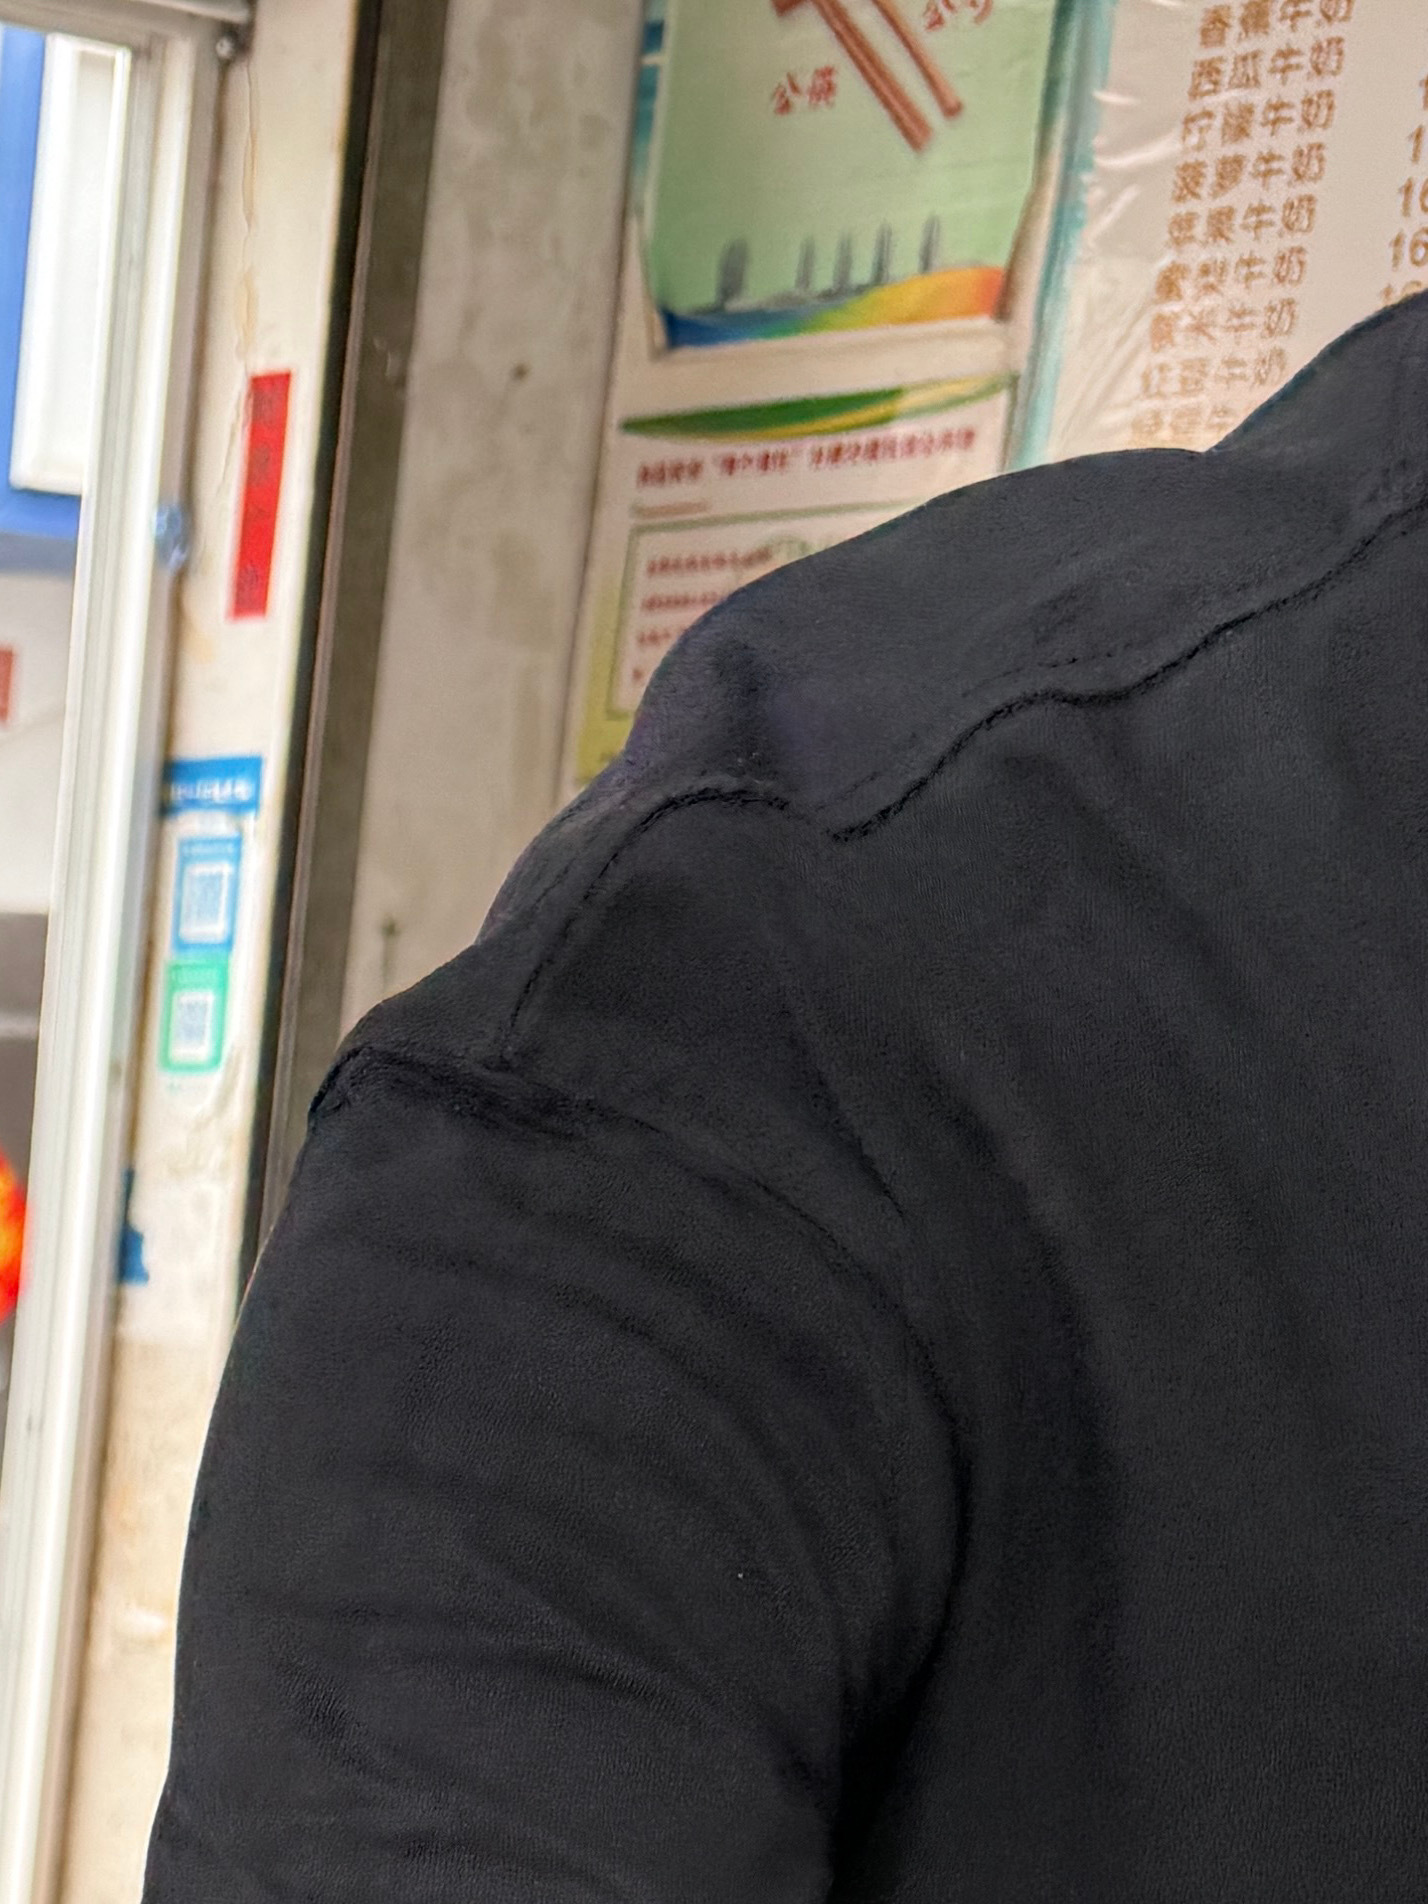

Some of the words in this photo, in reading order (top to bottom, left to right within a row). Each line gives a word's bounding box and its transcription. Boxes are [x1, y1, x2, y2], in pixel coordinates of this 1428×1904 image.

[1187, 36, 1346, 99] 西瓜牛奶
[1172, 142, 1327, 205] 菠萝牛奶
[1166, 194, 1317, 248] 苹果牛奶
